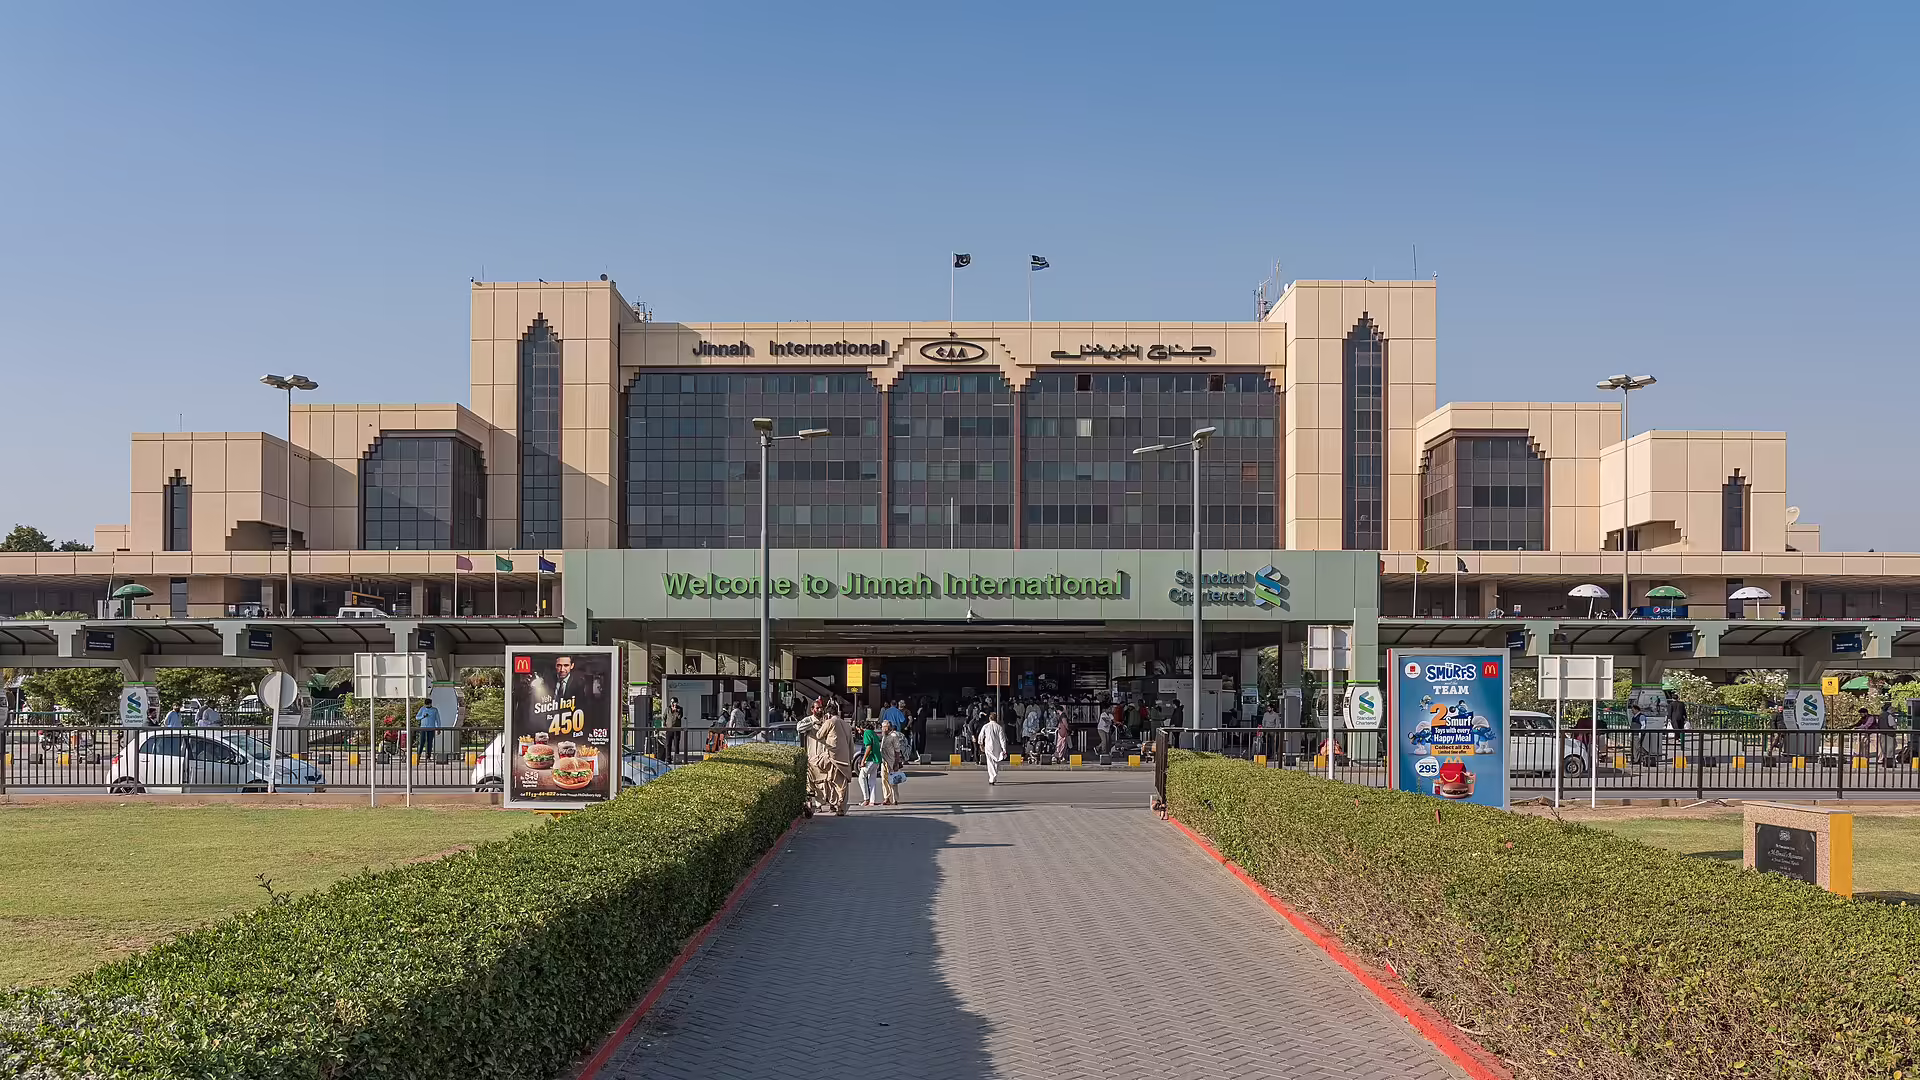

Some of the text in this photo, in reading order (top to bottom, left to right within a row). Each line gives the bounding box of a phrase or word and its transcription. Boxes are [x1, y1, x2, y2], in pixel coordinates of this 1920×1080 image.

[693, 339, 887, 357] Jinnah International
[661, 571, 1122, 595] Welcome to Jinnah International
[1175, 569, 1248, 585] Stndard
[1168, 587, 1247, 602] Chrtered
[1426, 664, 1476, 681] SMURFS
[1432, 685, 1470, 695] TEAM
[534, 699, 559, 714] Such
[549, 709, 584, 736] 450
[1430, 703, 1472, 727] 2 Smurf
[1434, 727, 1446, 735] Toys
[1446, 726, 1456, 734] with
[1433, 733, 1472, 744] Happy Meal
[1418, 764, 1438, 774] 295
